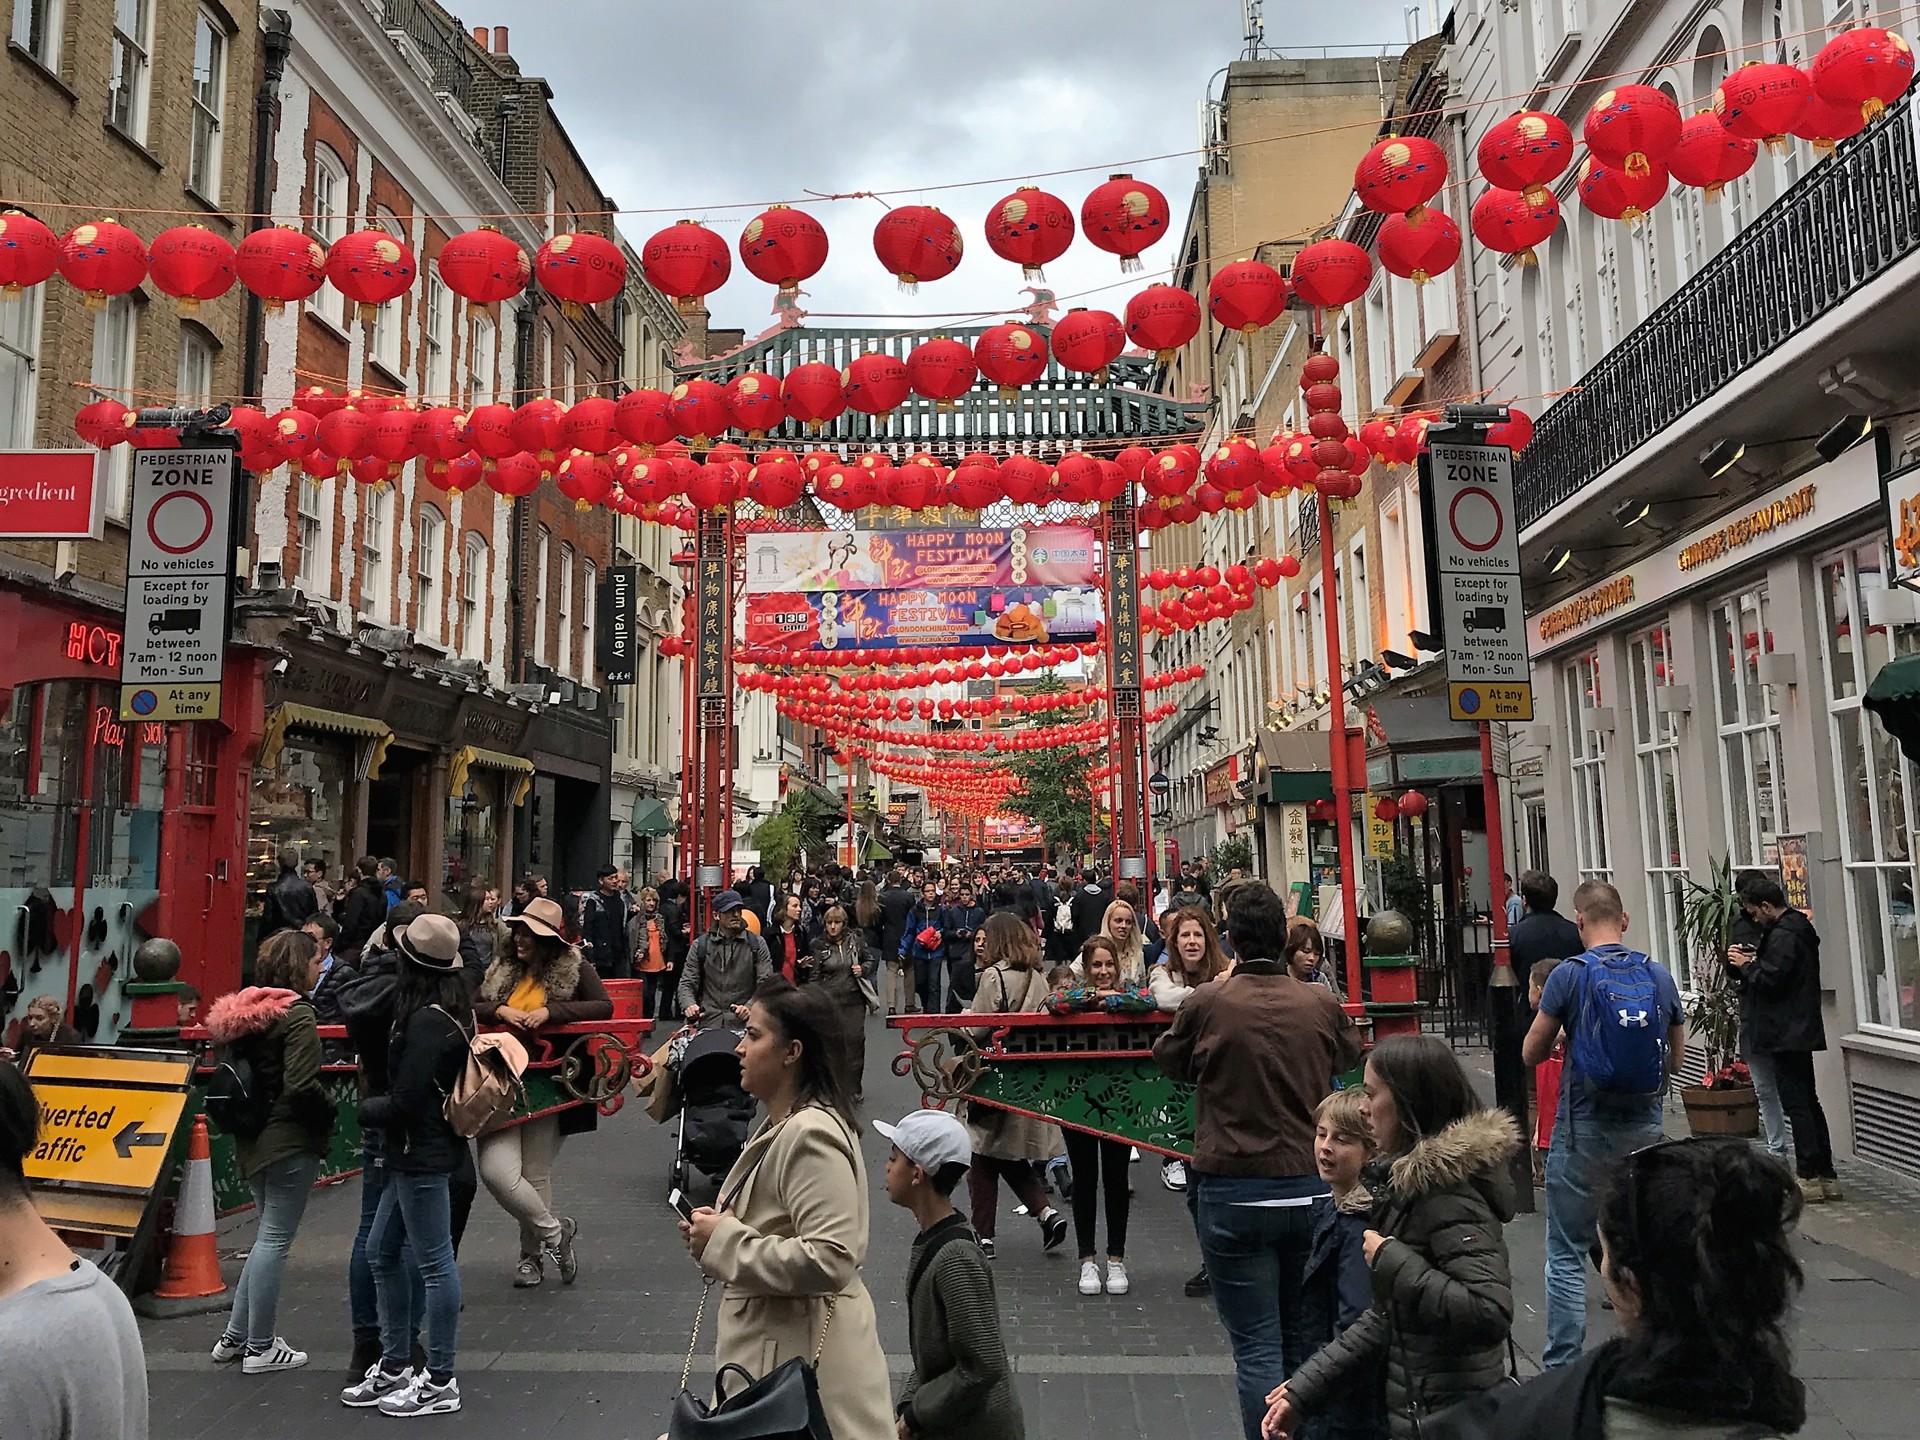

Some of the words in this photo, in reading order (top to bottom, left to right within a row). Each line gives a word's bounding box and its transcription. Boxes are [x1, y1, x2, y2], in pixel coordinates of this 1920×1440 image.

[140, 454, 227, 465] PEDESTRIAN
[1435, 449, 1507, 463] PEDESTRIAN
[151, 469, 213, 486] ZONE
[1447, 465, 1499, 483] ZONE
[1677, 529, 1725, 571] CHINESE
[1726, 483, 1814, 549] RESTAURANT
[906, 533, 955, 547] HAPPY
[965, 531, 1004, 546] MOON
[916, 548, 993, 562] FESTIVAL
[141, 560, 159, 570] No
[163, 559, 214, 570] vehicles
[1449, 556, 1465, 567] No
[1467, 556, 1510, 568] vehicles
[915, 564, 996, 575] @LONDONCHINATOWN
[144, 581, 187, 592] Except
[191, 580, 209, 590] for
[1454, 577, 1490, 590] Except
[1493, 578, 1508, 589] for
[613, 574, 628, 609] plum
[1455, 591, 1493, 604] loading
[1496, 592, 1509, 604] by
[143, 594, 189, 606] loading
[193, 594, 208, 605] by
[879, 592, 928, 606] HAPPY
[937, 590, 977, 604] MOON
[888, 607, 967, 622] FESTIVAL
[888, 624, 969, 634] @LONDONCHINATOWN
[612, 613, 628, 658] valley
[1464, 636, 1508, 647] between
[146, 638, 201, 649] between
[129, 652, 156, 663] 7am
[168, 651, 182, 662] 12
[186, 652, 217, 662] noon
[1450, 650, 1474, 661] 7am
[1483, 650, 1495, 661] 12
[1498, 651, 1523, 661] noon
[140, 666, 168, 676] Mon
[178, 665, 204, 675] Sun
[1462, 664, 1485, 675] Mon
[1493, 664, 1514, 675] Sun
[168, 690, 184, 700] At
[188, 690, 211, 702] any
[1489, 689, 1502, 699] At
[1504, 689, 1523, 701] any
[175, 704, 203, 714] time
[1495, 703, 1519, 714] time
[93, 706, 127, 757] Play
[39, 1101, 116, 1130] iverted
[25, 1137, 87, 1162] affic
